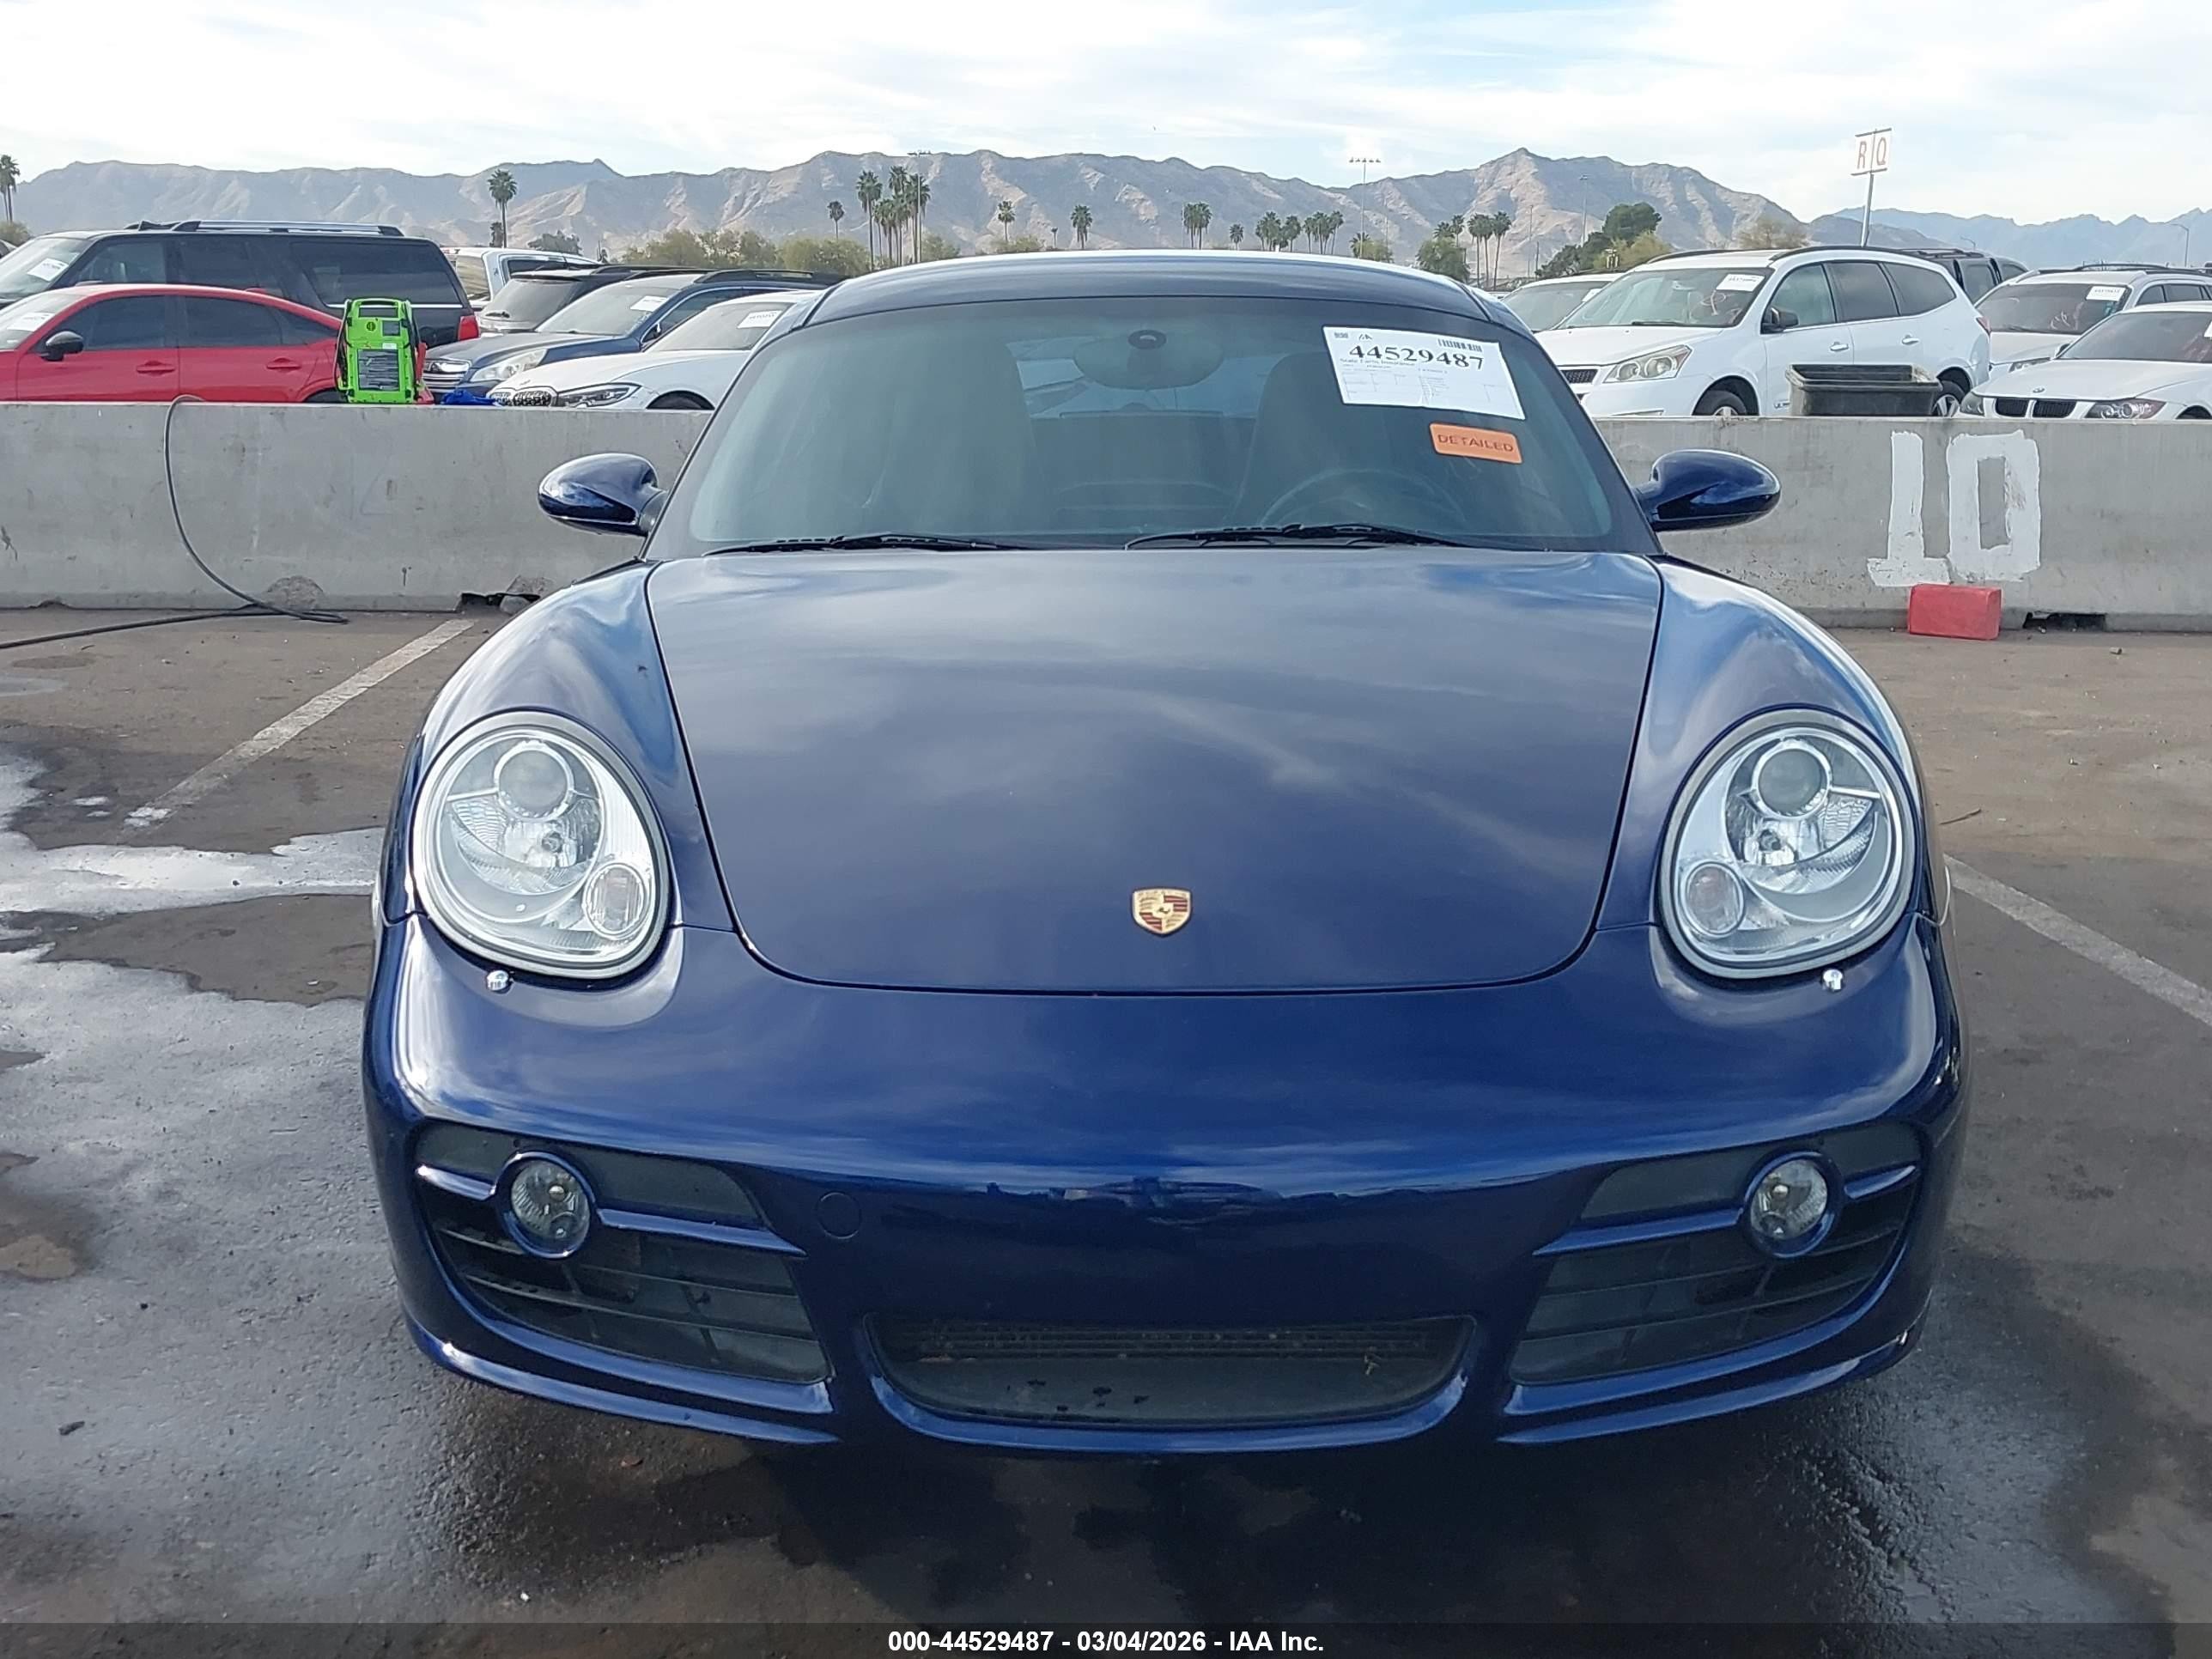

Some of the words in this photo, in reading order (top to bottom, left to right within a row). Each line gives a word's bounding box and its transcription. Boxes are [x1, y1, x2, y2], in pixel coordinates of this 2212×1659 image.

[1349, 345, 1484, 370] 44529487
[1437, 433, 1514, 453] DETAILED
[1867, 429, 2041, 587] 10
